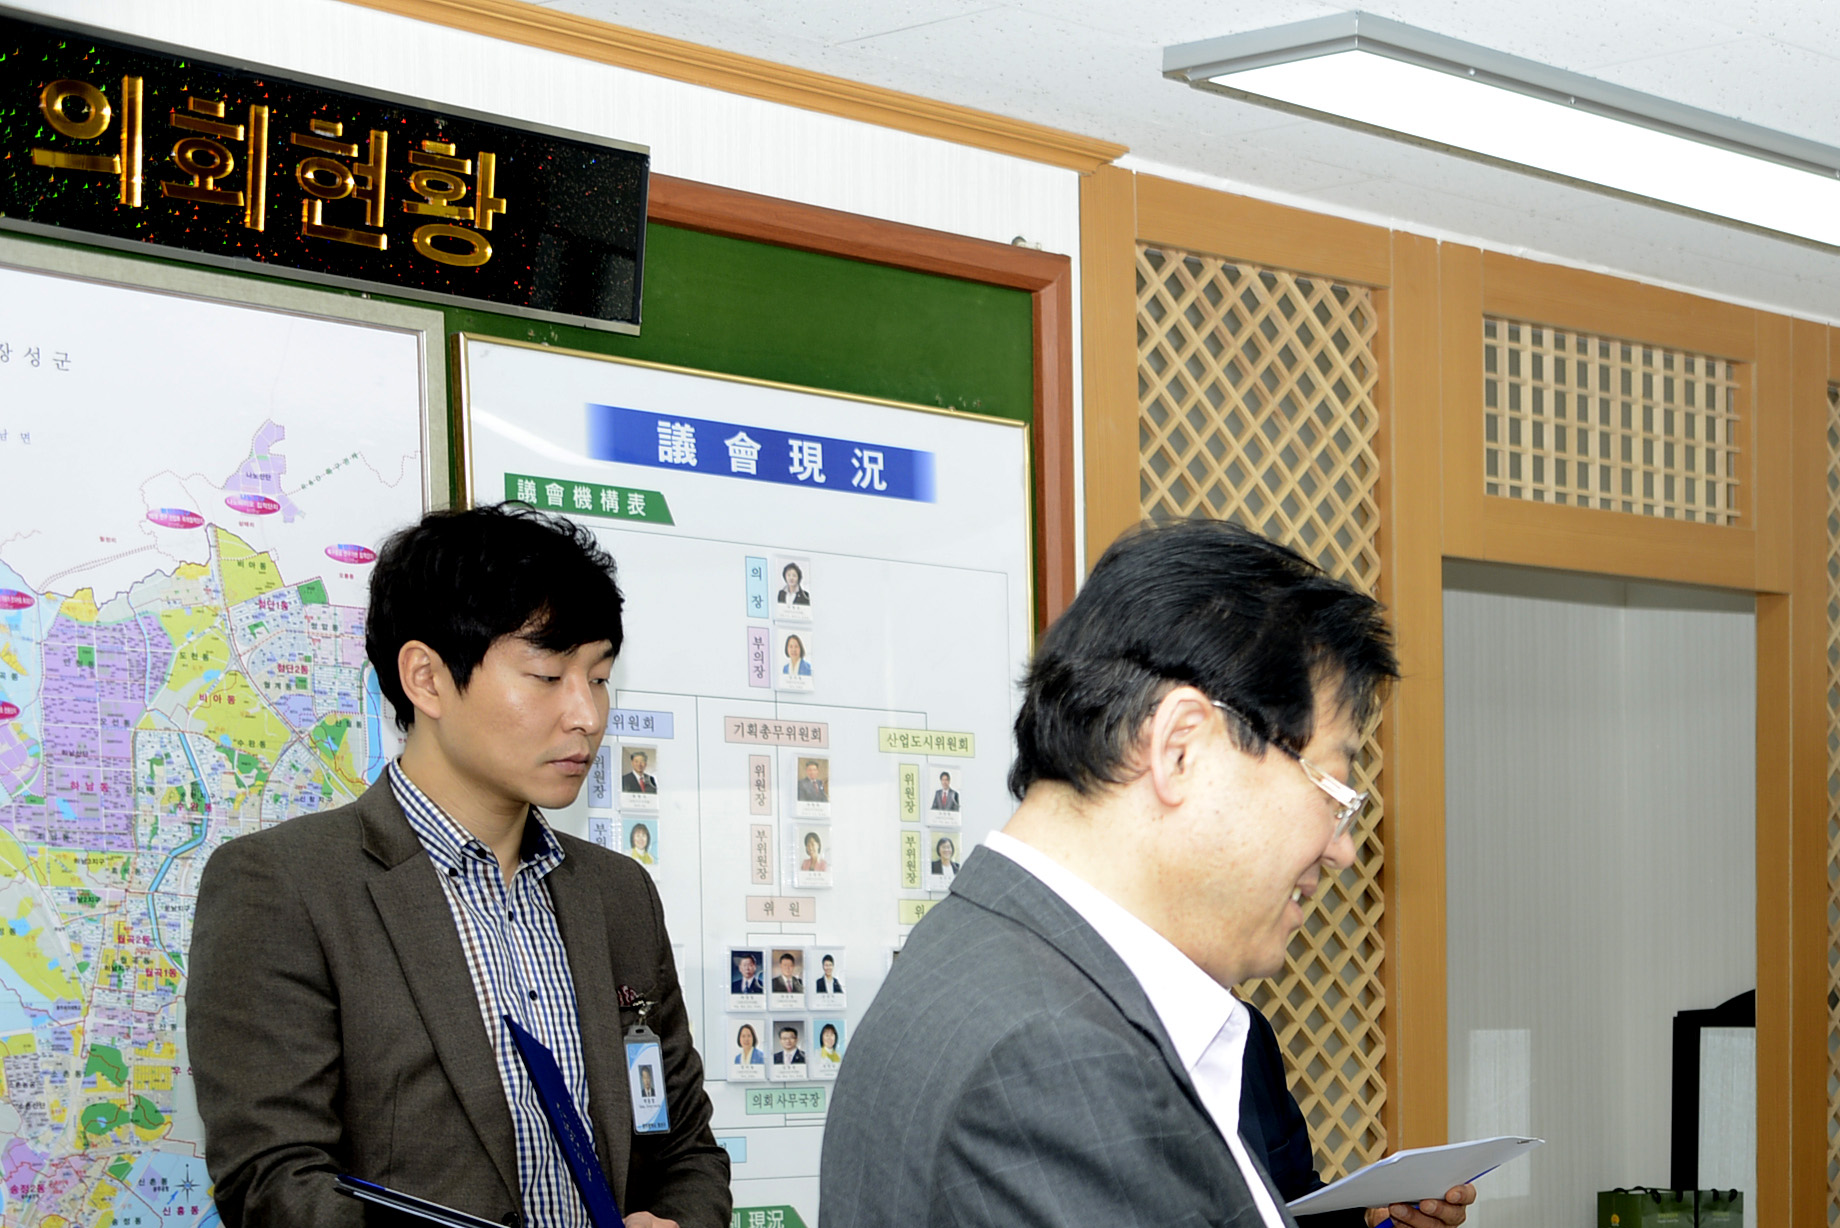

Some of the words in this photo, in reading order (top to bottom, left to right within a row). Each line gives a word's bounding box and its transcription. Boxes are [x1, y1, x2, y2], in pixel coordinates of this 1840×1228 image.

[32, 74, 506, 268] 의회현황
[656, 419, 888, 492] 議會現況
[516, 478, 646, 517] 議會機構表
[753, 637, 765, 679] 부의장
[199, 694, 235, 705] 비아동
[607, 713, 656, 733] 위원회
[733, 722, 822, 743] 기획총무위원회
[886, 732, 969, 752] 산업도시위원회
[70, 781, 109, 793] 하남동
[755, 764, 766, 806] 위원장
[904, 773, 915, 814] 위원장
[177, 802, 213, 813] 수완동
[755, 829, 768, 880] 부위원장
[906, 836, 917, 884] 부위원장
[763, 901, 801, 918] 위원
[118, 935, 151, 944] 월곡2동
[146, 968, 177, 978] 월곡1동
[752, 1093, 774, 1109] 의회
[776, 1092, 821, 1108] 사무국장
[10, 1184, 45, 1195] 송정2동
[163, 1206, 199, 1216] 신흥동
